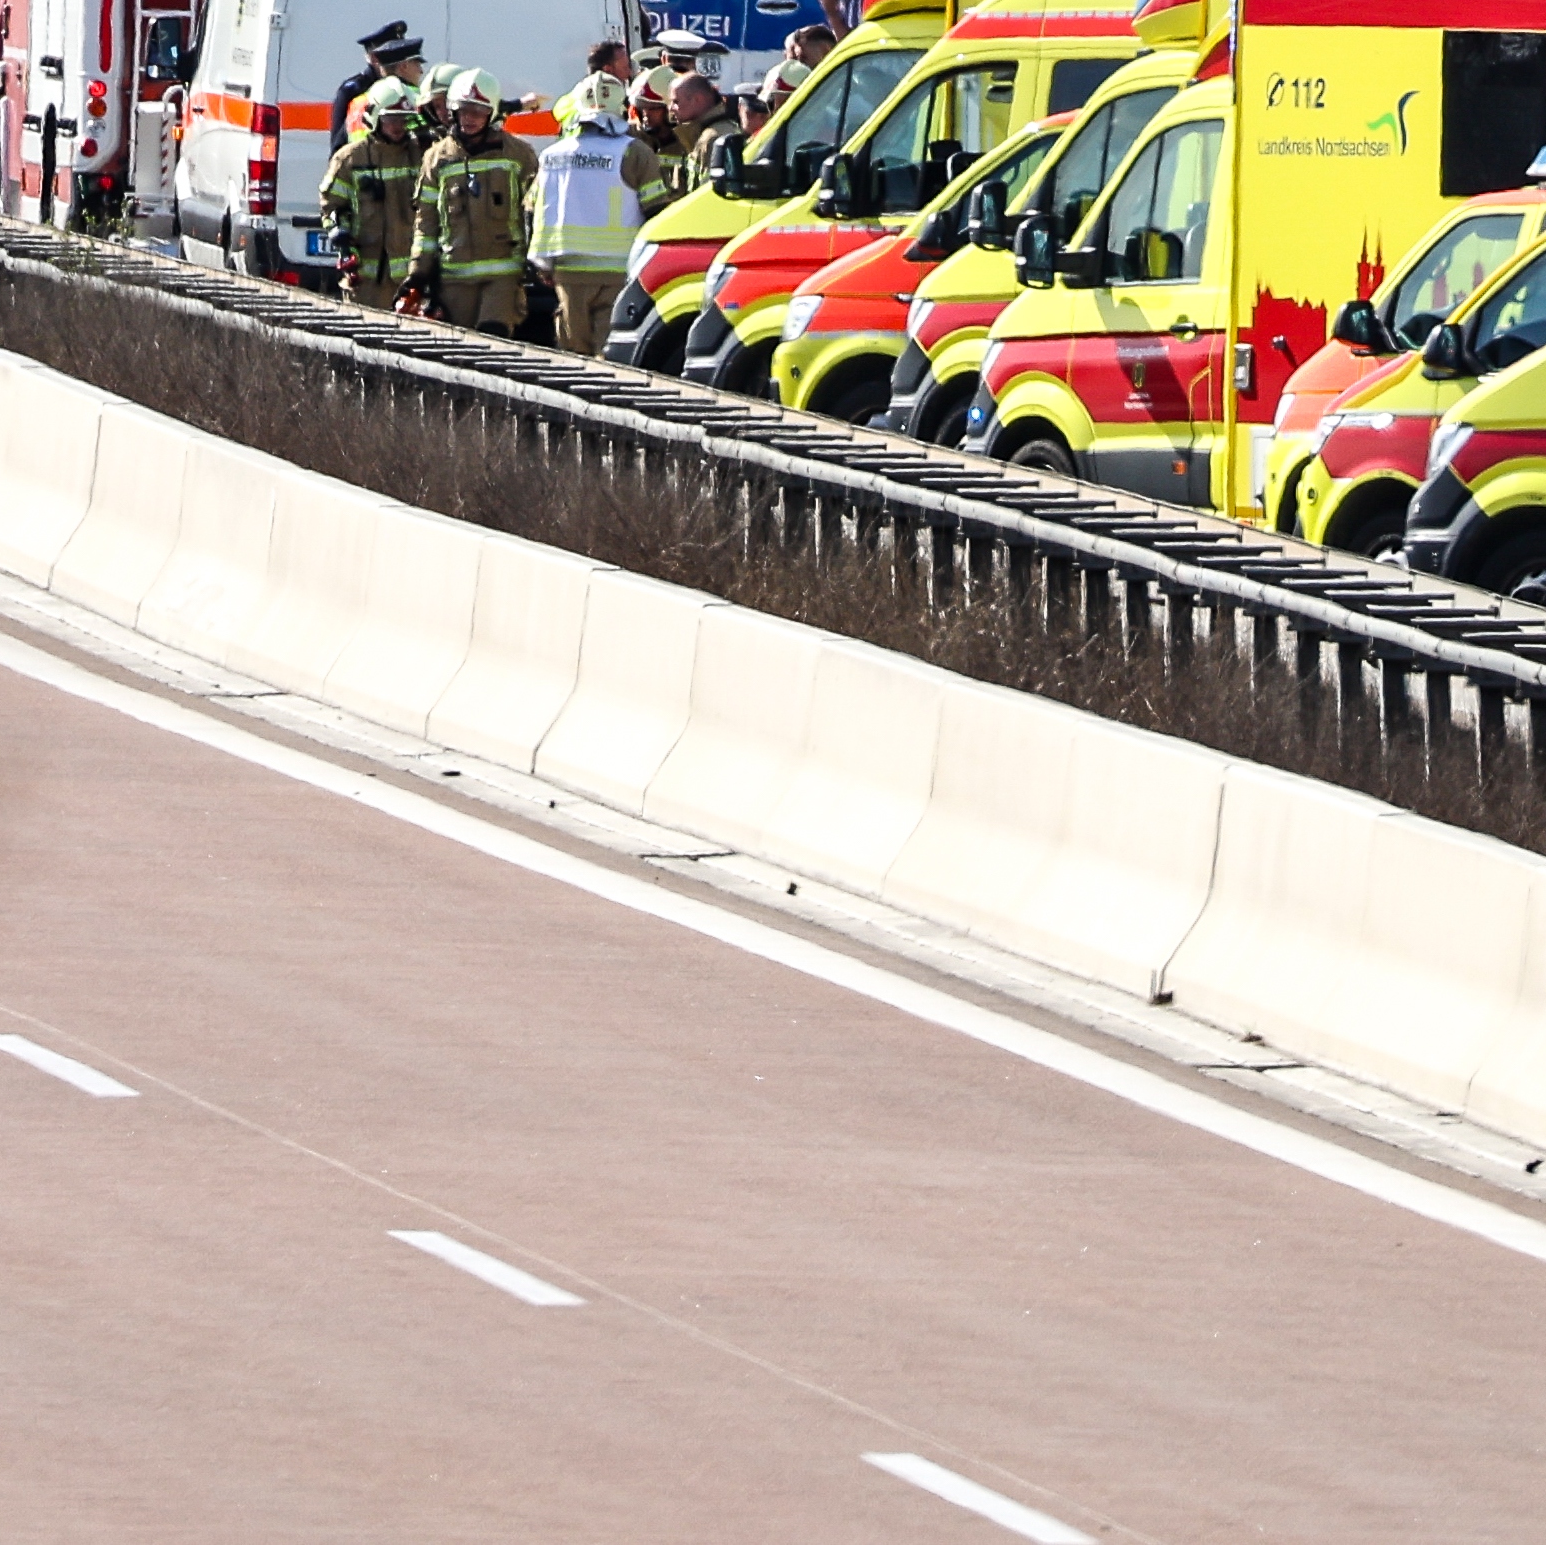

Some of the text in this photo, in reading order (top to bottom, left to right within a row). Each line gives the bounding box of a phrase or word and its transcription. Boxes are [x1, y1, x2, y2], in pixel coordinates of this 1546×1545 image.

[648, 11, 731, 37] OLIZEI
[1291, 77, 1327, 110] 112
[1257, 136, 1391, 157] Landkreis Nordsachsen
